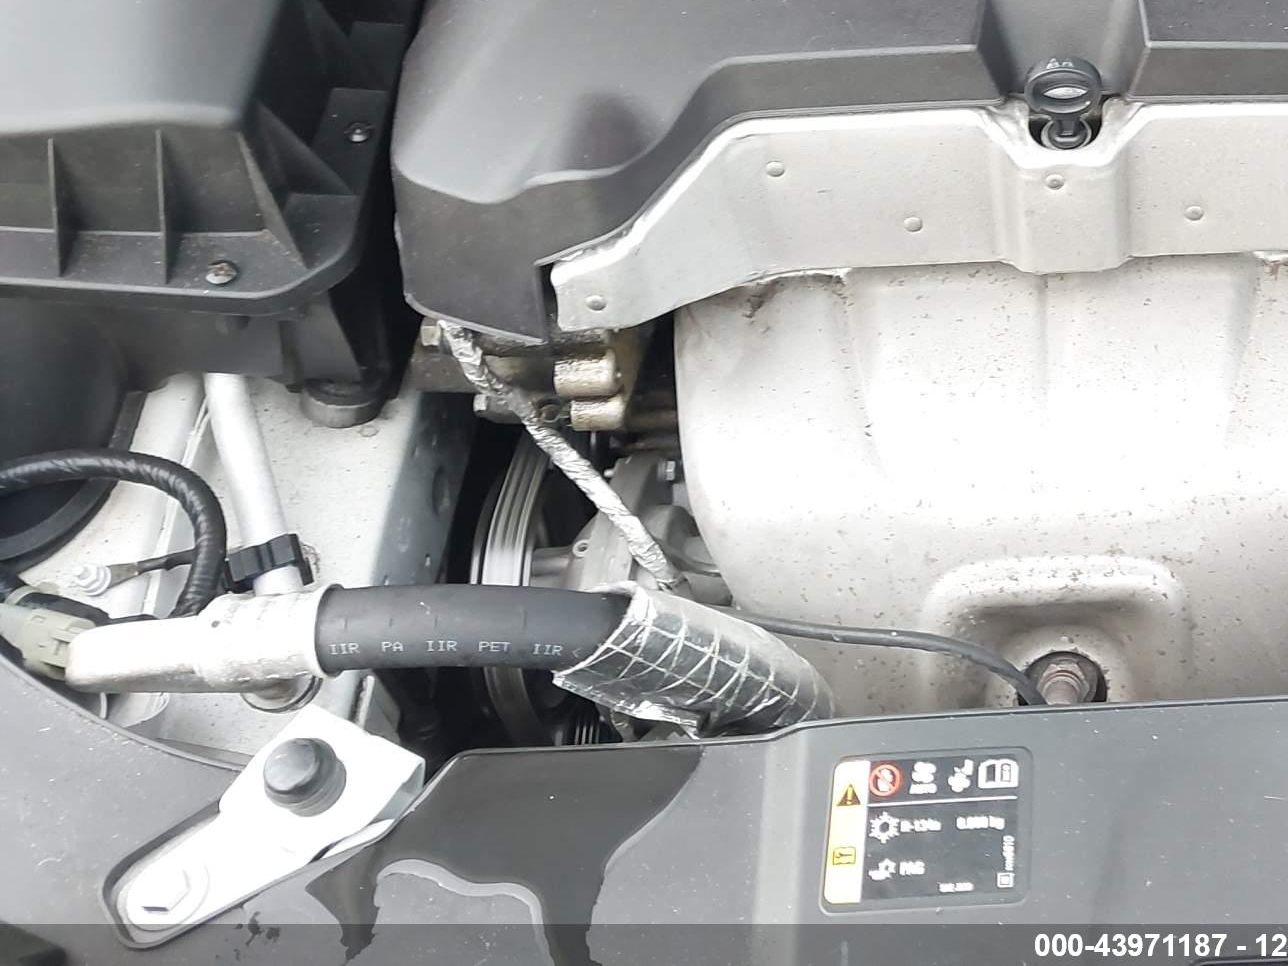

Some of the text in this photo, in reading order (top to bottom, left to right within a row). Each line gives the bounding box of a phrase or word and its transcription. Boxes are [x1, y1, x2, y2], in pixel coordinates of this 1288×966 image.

[381, 641, 404, 652] PA
[424, 640, 458, 652] IIR
[477, 640, 511, 653] PET
[532, 643, 565, 656] IIR
